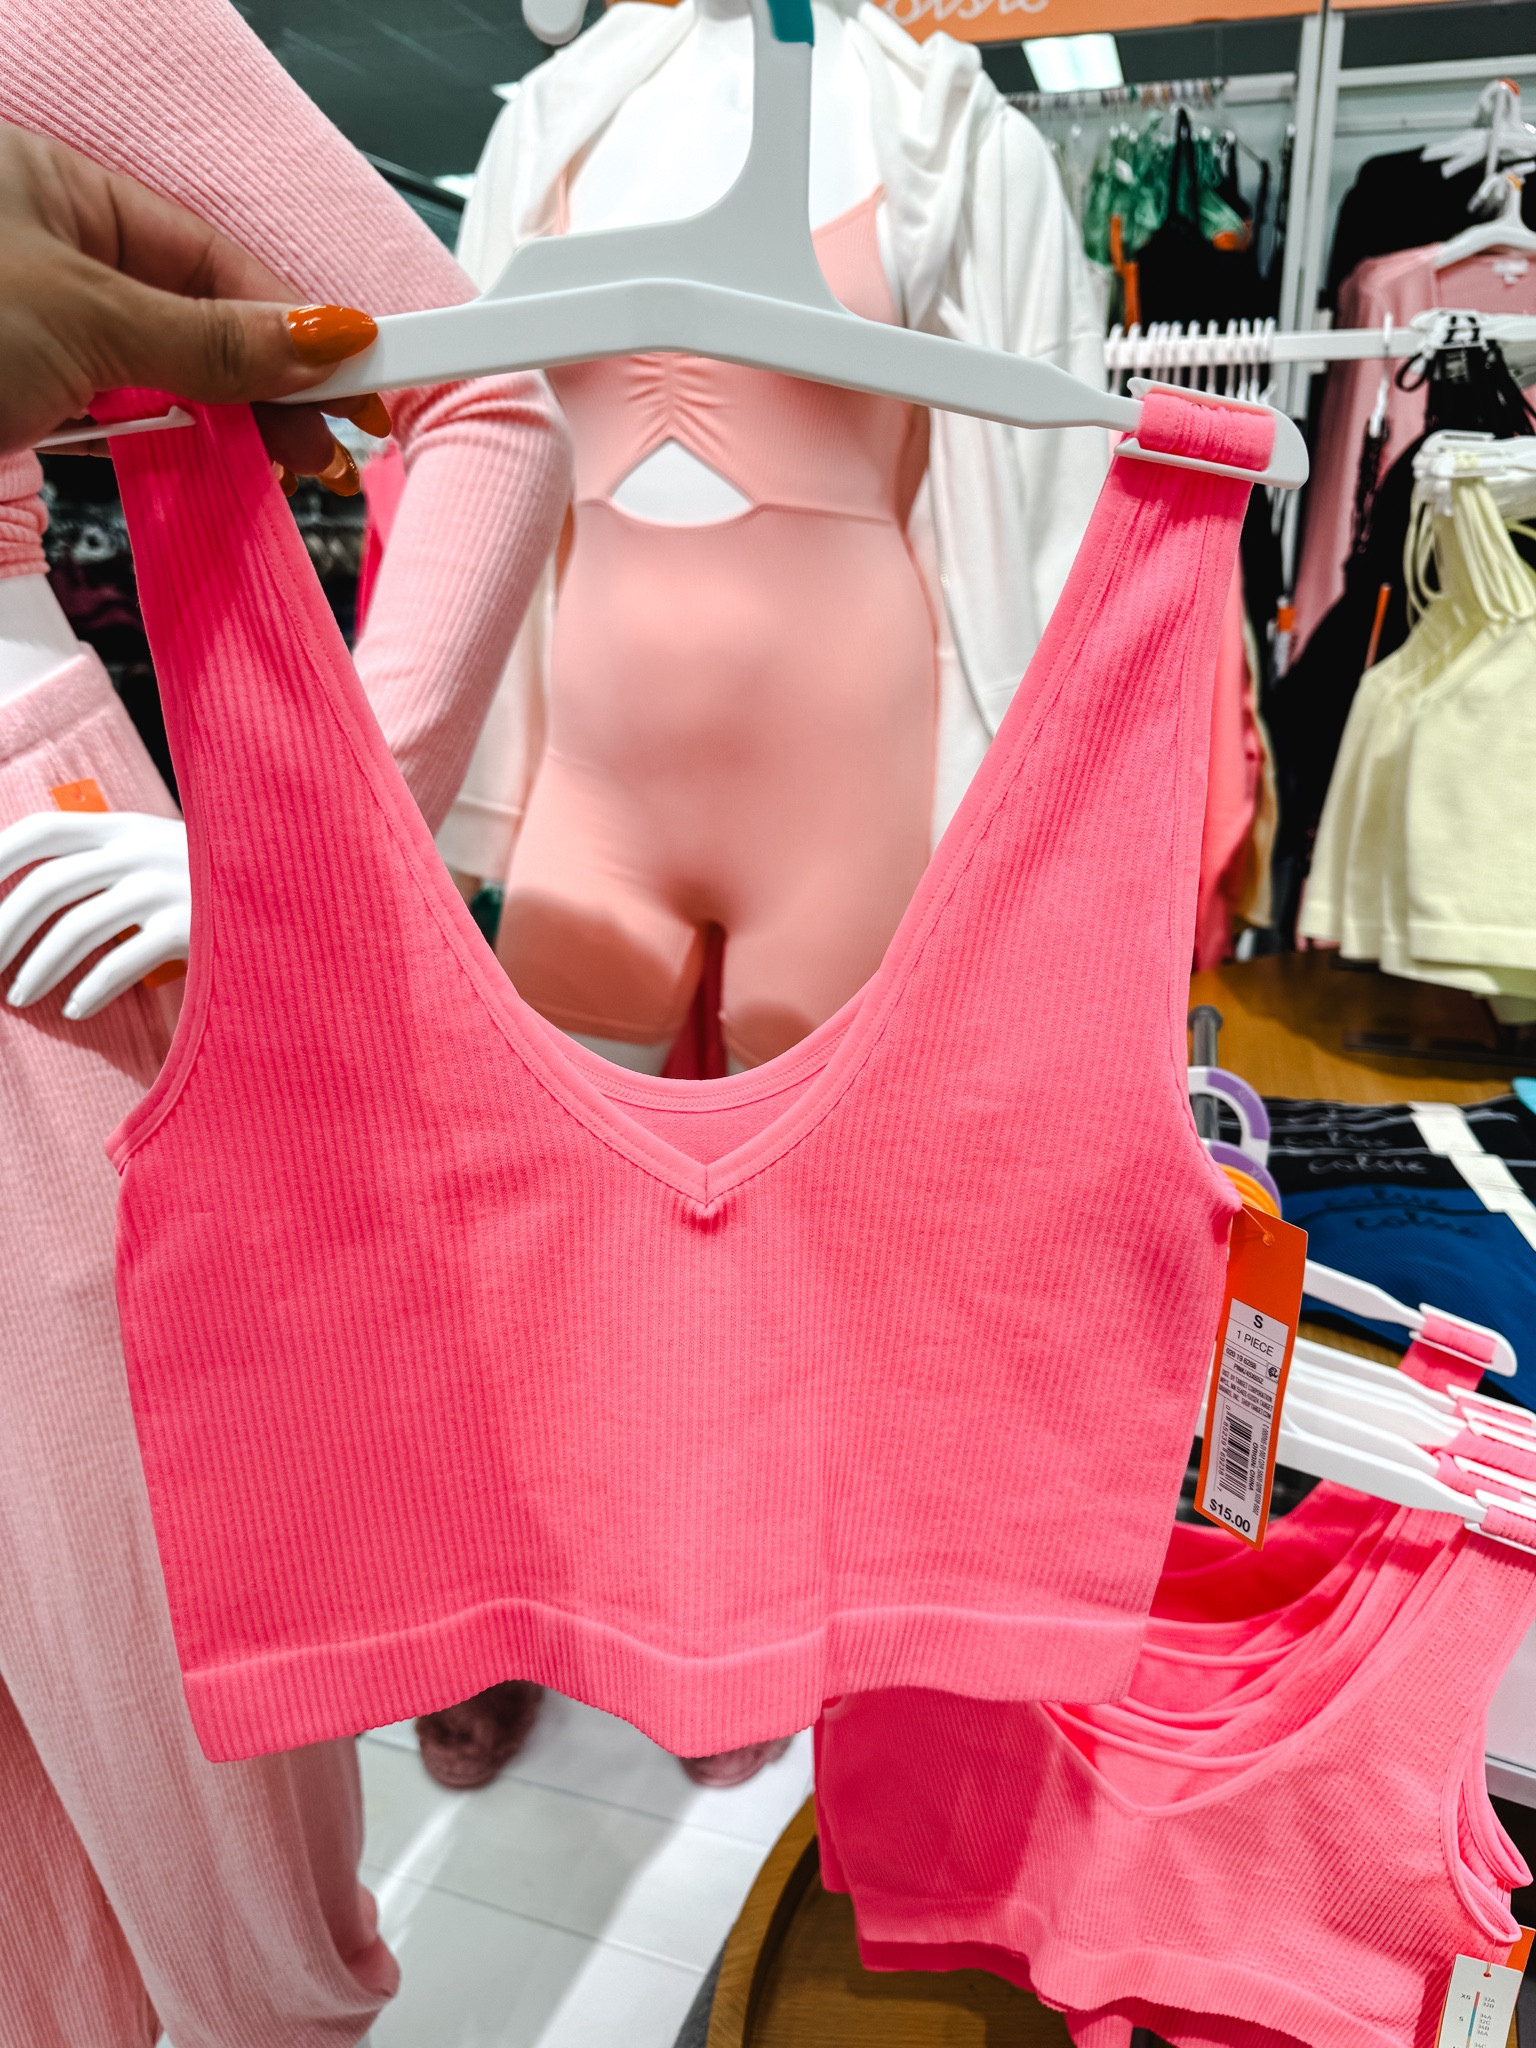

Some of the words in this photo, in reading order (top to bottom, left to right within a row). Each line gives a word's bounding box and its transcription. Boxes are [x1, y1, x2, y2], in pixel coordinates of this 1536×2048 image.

[1253, 1314, 1264, 1329] S
[1237, 1330, 1242, 1339] 1
[1243, 1333, 1275, 1357] PIECE
[1248, 1469, 1256, 1491] CHINA
[1209, 1498, 1251, 1533] $15.00
